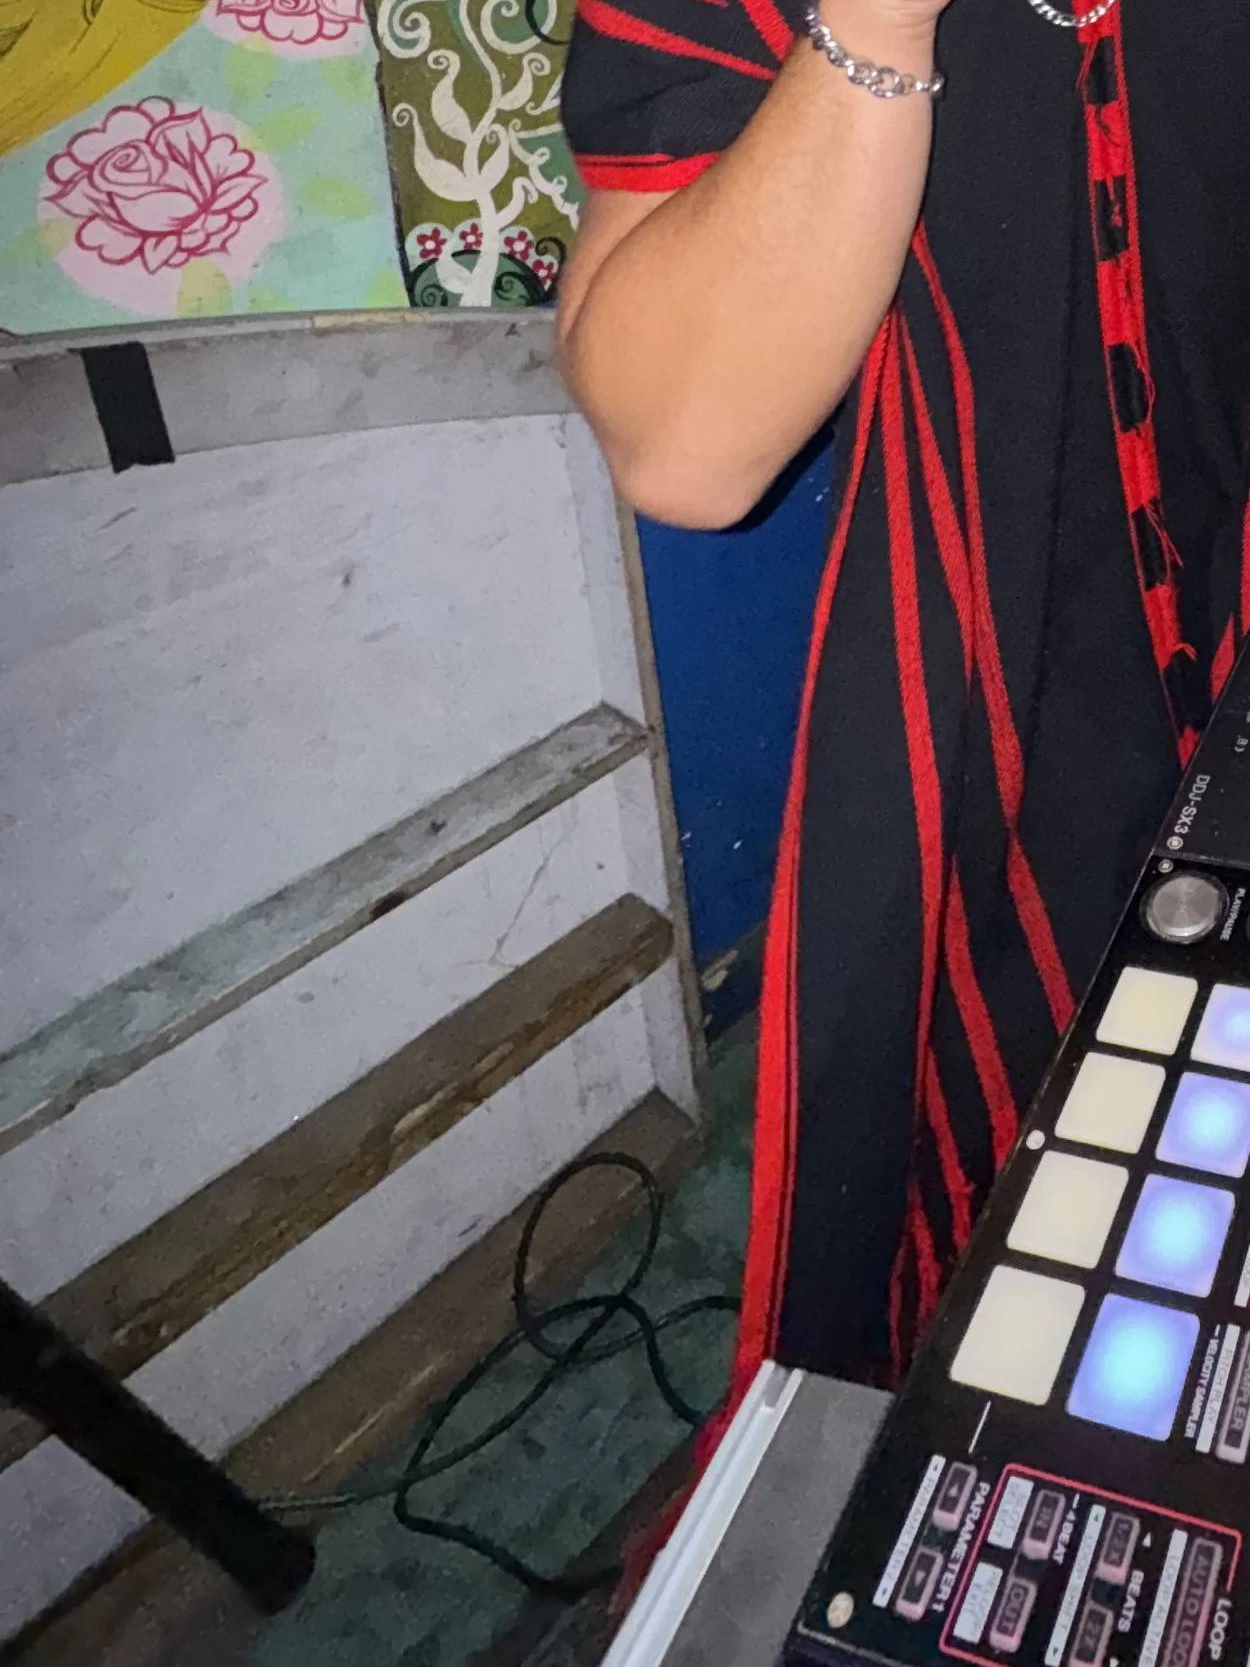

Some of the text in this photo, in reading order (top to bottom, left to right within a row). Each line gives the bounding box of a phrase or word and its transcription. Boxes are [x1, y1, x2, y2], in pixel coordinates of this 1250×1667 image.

[1174, 774, 1211, 835] DDJ-SX3
[1220, 886, 1246, 942] PLAY/PAUSE
[942, 1481, 991, 1602] PARAMETER
[1052, 1522, 1074, 1564] BEAT
[998, 1587, 1026, 1632] OUT
[1117, 1569, 1146, 1633] BEATS
[1207, 1598, 1233, 1661] LOOP
